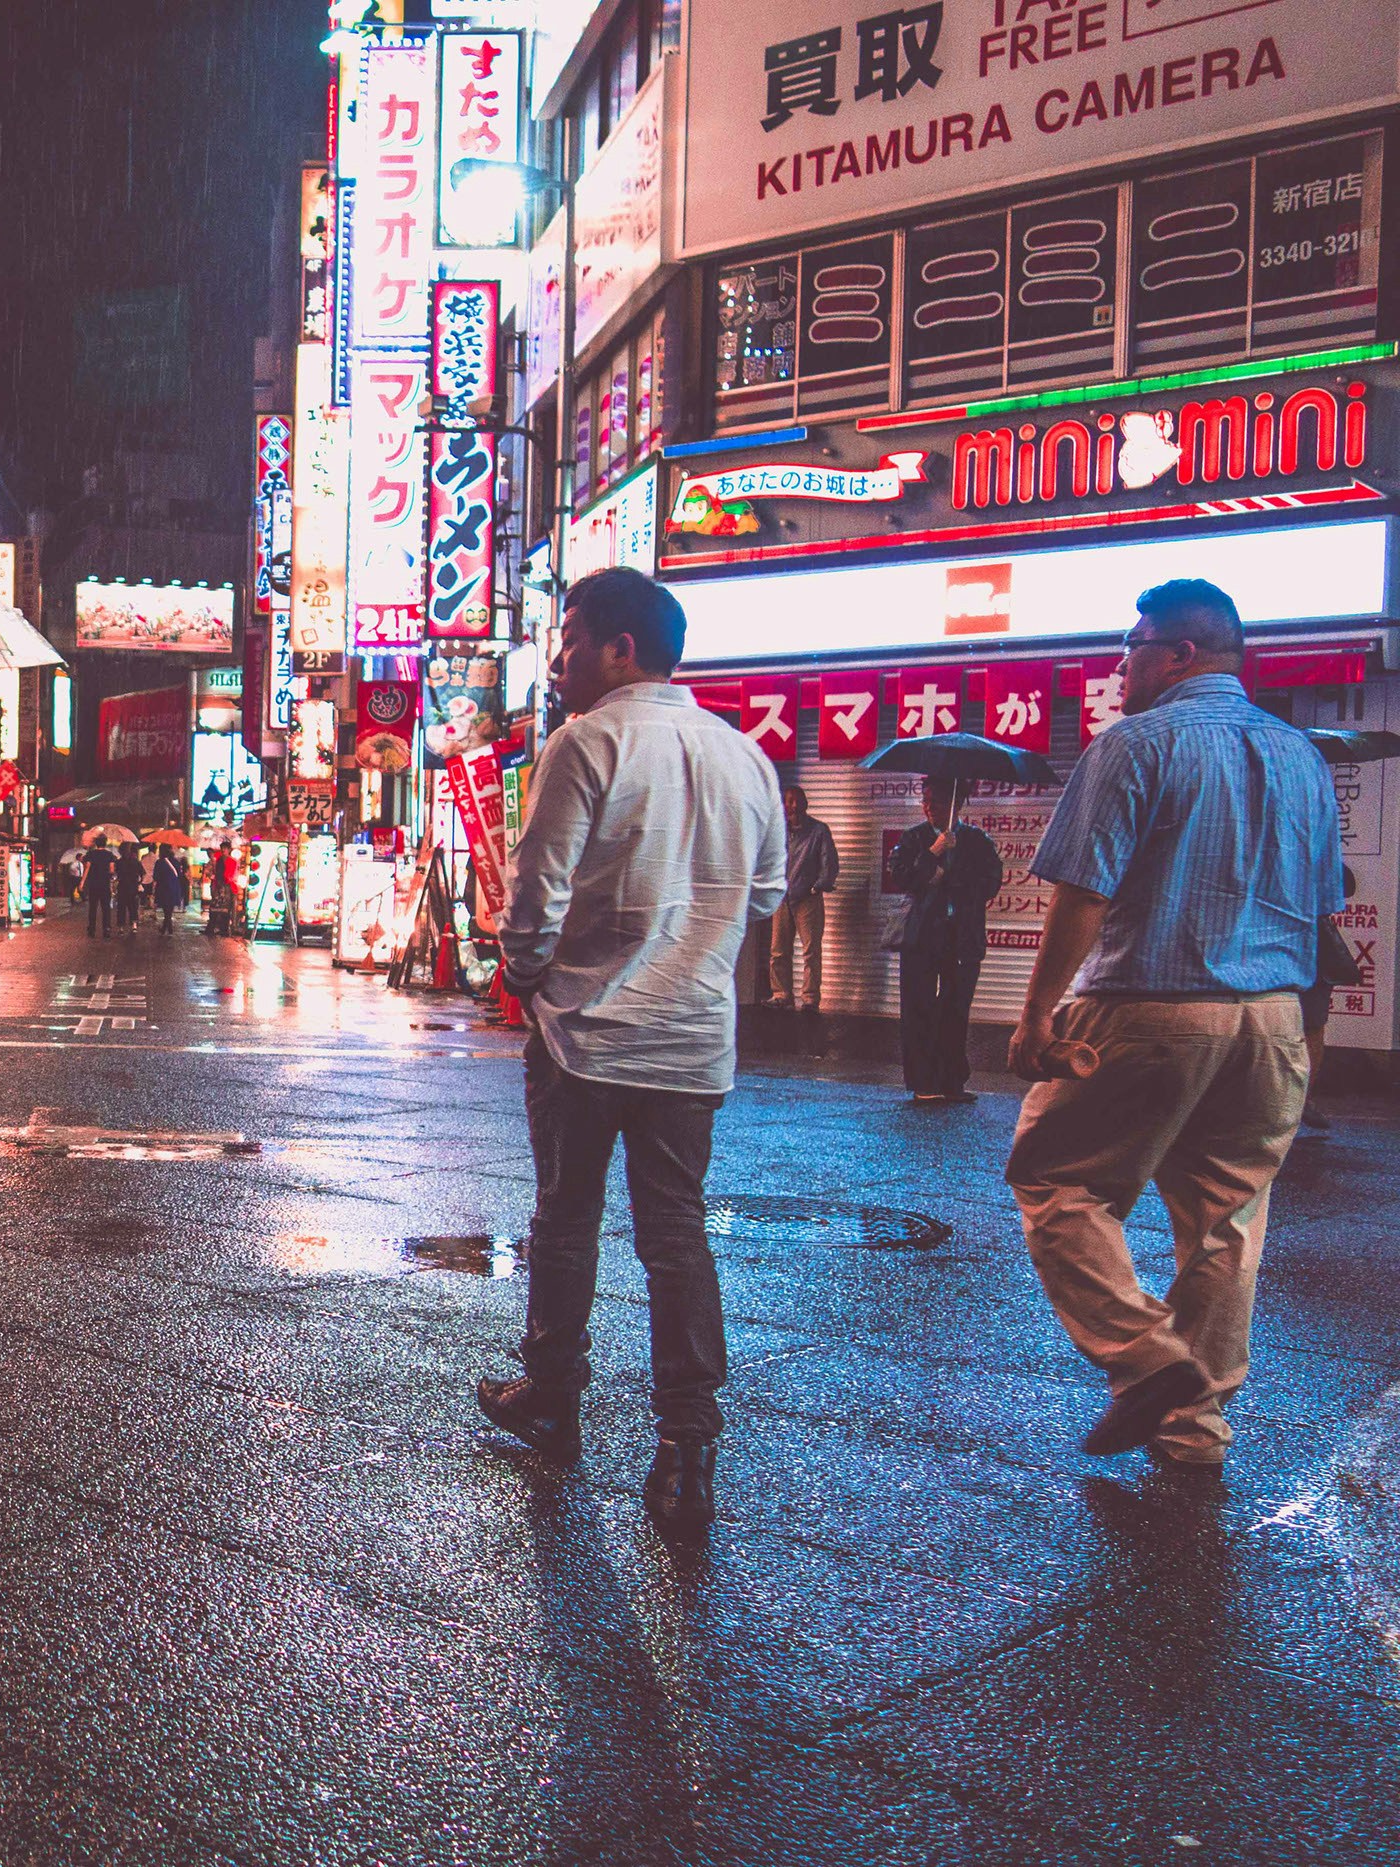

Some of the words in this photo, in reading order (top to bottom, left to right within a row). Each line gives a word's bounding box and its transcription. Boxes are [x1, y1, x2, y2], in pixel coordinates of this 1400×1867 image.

[760, 2, 943, 131] 買取
[979, 4, 1107, 78] FREE
[757, 104, 1012, 200] KITAMURA
[1034, 37, 1287, 134] CAMERA
[375, 94, 420, 319] カラオケ
[1272, 172, 1363, 213] 新宿店
[368, 374, 416, 522] マック
[953, 413, 1115, 511] mini
[1177, 381, 1367, 487] mini
[433, 431, 489, 621] ラーメン
[303, 652, 329, 670] 2F
[357, 608, 421, 642] 24h
[290, 794, 331, 810] チカラ
[307, 807, 331, 821] めし
[987, 930, 1042, 947] kitam
